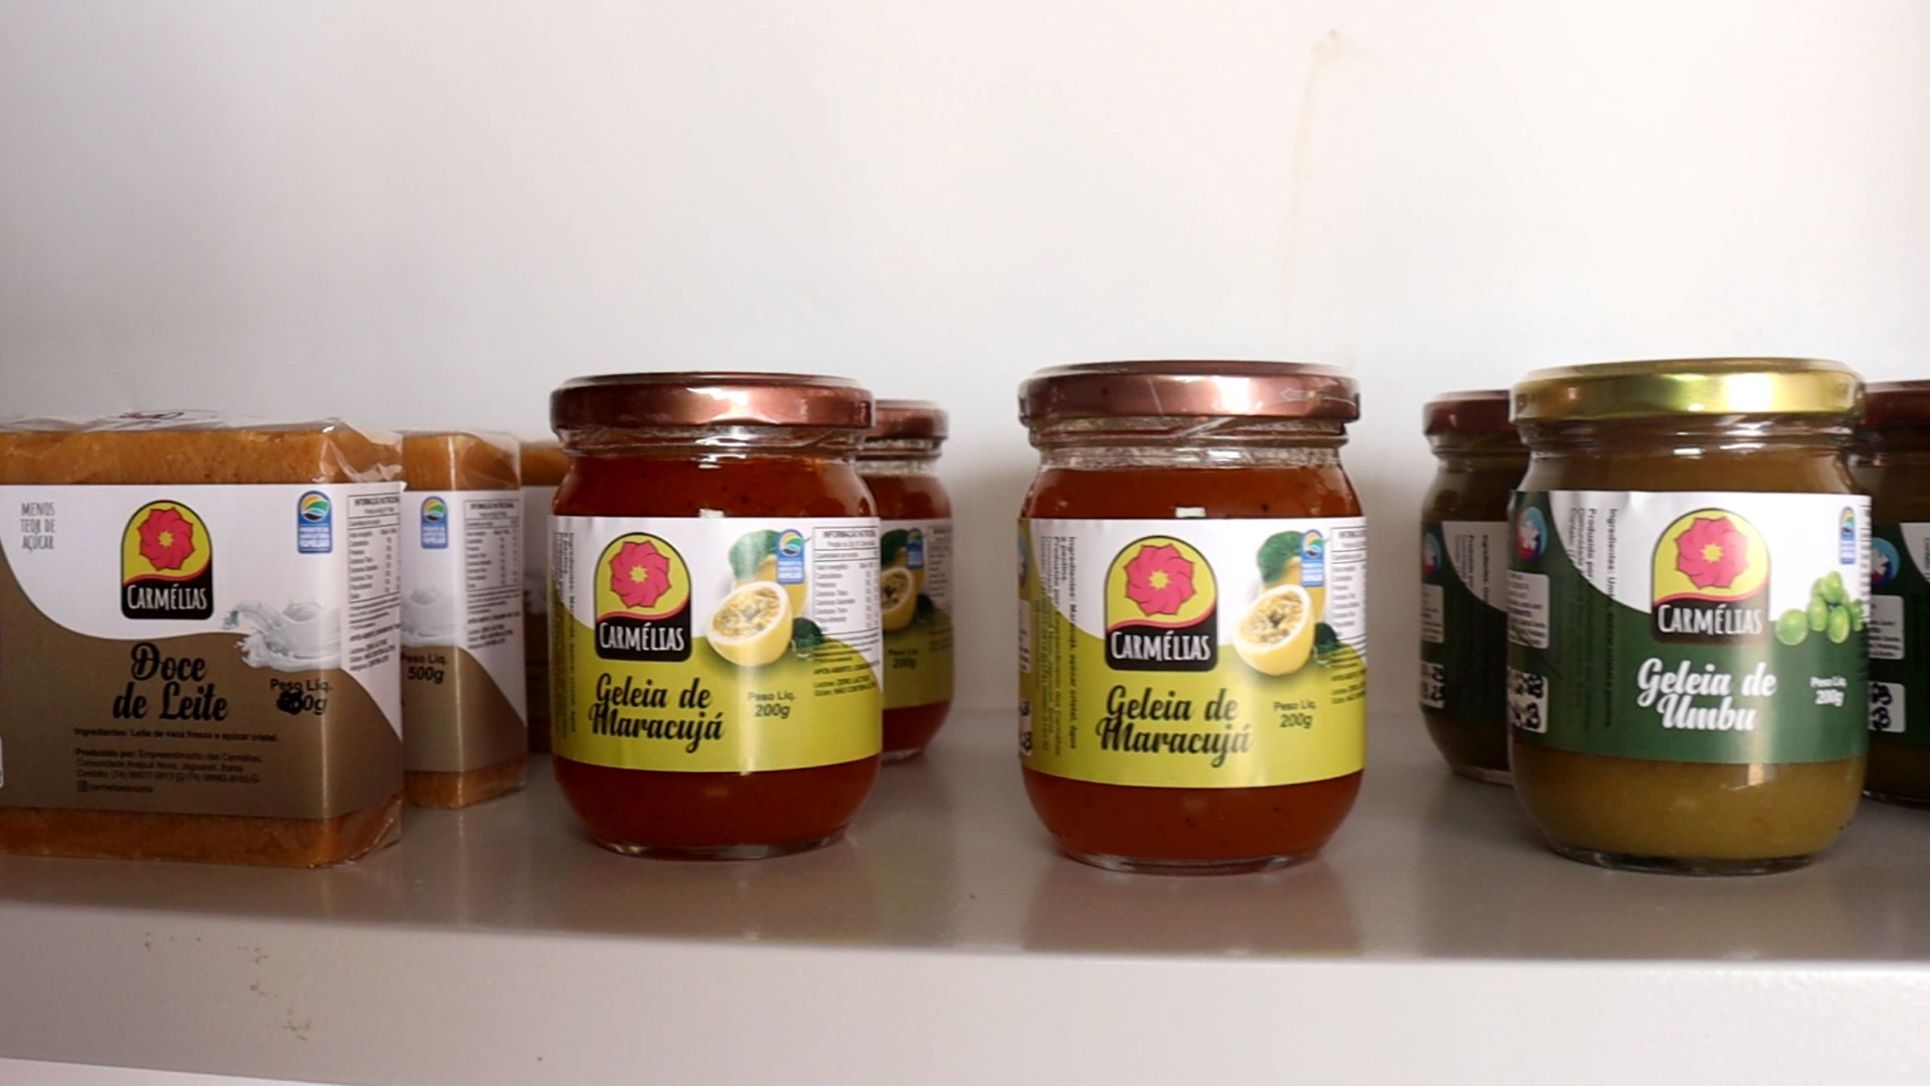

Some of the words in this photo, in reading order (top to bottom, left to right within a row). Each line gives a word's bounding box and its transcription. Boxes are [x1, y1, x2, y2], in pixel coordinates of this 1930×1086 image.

[21, 502, 56, 517] MENOS
[44, 518, 56, 533] DE
[1607, 509, 1618, 573] Ingredientes:
[127, 583, 208, 611] CARMÉLIAS
[1658, 604, 1763, 635] CARMÉLIAS
[600, 622, 685, 652] CARMÉLIAS
[1111, 630, 1211, 661] CARMÉLIAS
[131, 642, 205, 682] Doce
[407, 666, 445, 685] 500g
[270, 678, 302, 690] Peso
[596, 672, 668, 709] Geleia
[679, 677, 711, 709] de
[747, 691, 775, 701] Peso
[1637, 657, 1732, 708] Geleia
[1741, 662, 1777, 697] de
[113, 681, 147, 719] de
[160, 681, 228, 721] Leite
[754, 703, 790, 720] 200g
[1106, 684, 1192, 721] Geleia
[1204, 687, 1239, 722] de
[1656, 692, 1757, 732] Umbu
[588, 702, 724, 754] Maracujá
[1280, 713, 1313, 730] 200g
[1096, 716, 1252, 769] Maracujá
